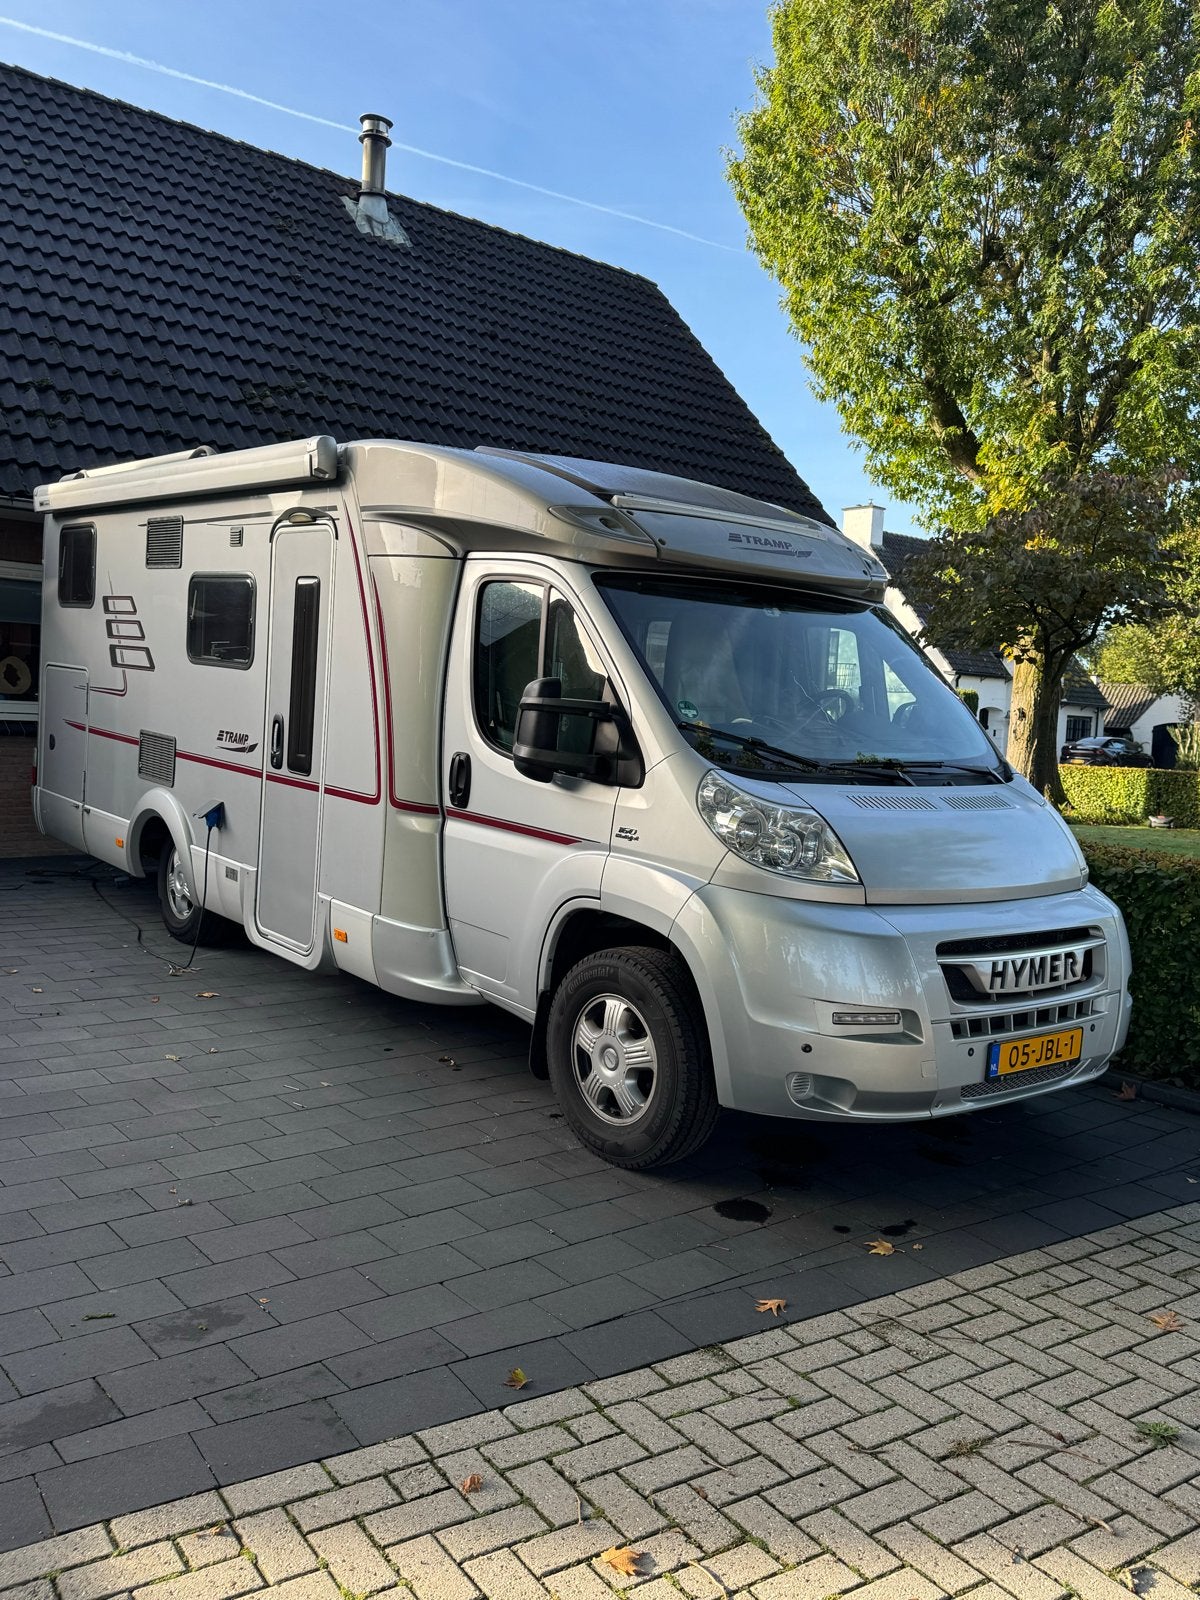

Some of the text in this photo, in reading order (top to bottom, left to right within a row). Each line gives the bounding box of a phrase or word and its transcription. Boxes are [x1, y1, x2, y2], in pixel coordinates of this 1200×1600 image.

[742, 534, 793, 550] TRAMP
[225, 731, 249, 745] TRAMP
[567, 966, 610, 993] Continental
[990, 952, 1080, 990] HYMER
[1008, 1034, 1075, 1068] 05-JBL-1
[990, 1063, 998, 1071] NL
